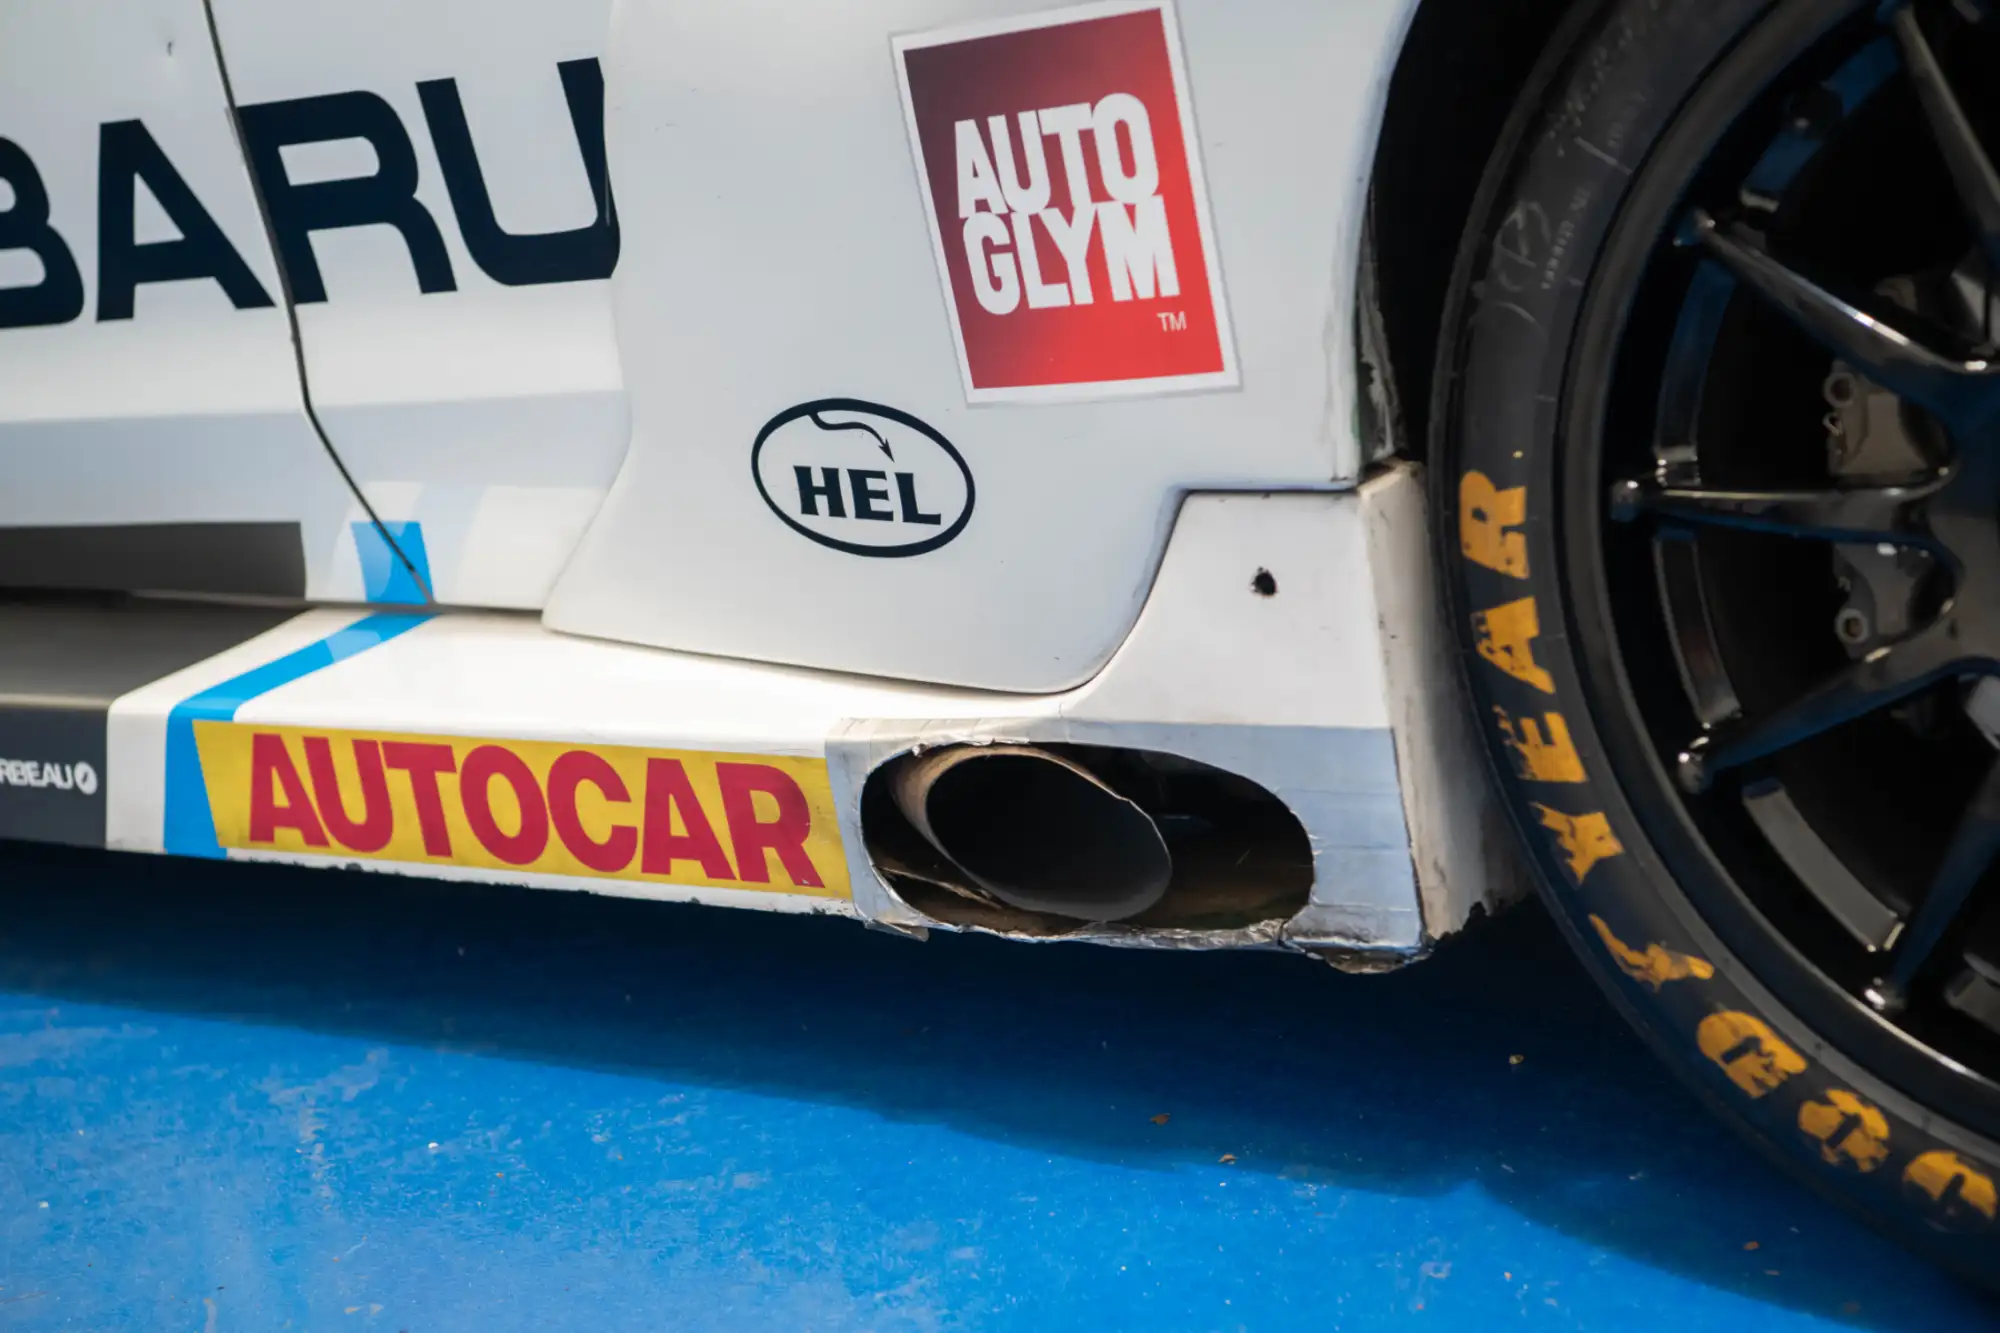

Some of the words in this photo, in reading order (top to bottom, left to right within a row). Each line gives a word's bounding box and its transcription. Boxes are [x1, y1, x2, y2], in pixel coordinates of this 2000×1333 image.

[953, 92, 1160, 219] AUTO
[962, 195, 1181, 315] GLYM
[792, 464, 942, 526] HEL
[248, 732, 826, 890] AUTOCAR
